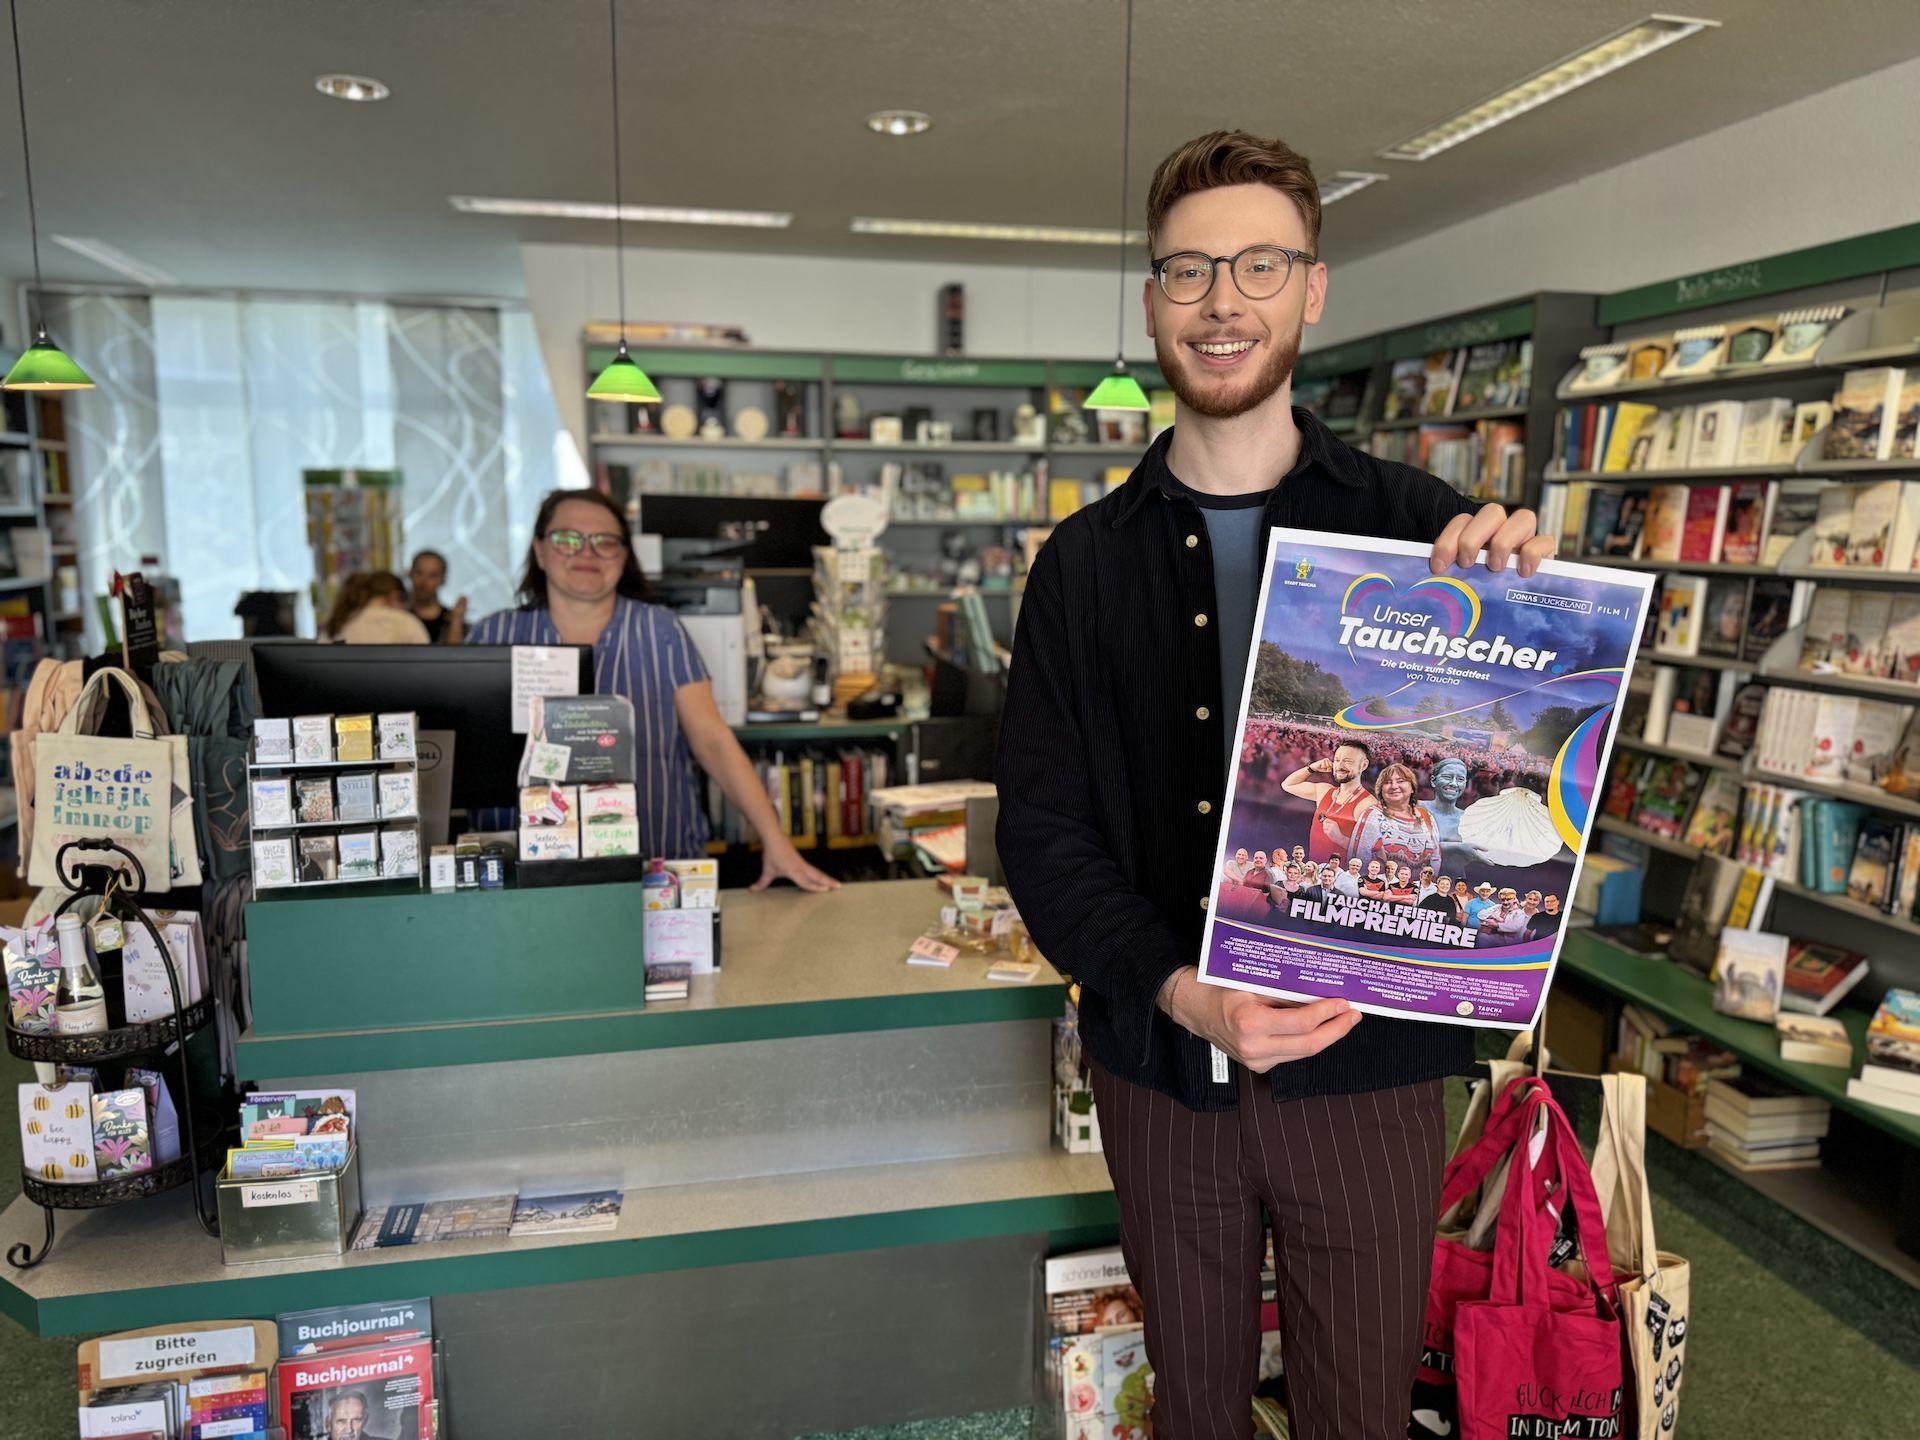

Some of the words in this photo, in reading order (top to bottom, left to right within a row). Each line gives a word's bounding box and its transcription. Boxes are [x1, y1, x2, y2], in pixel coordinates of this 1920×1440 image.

[1512, 592, 1538, 603] JONAS
[1540, 597, 1587, 610] JUCKELAND
[1597, 606, 1621, 616] FILM
[1374, 605, 1432, 627] Unser
[1381, 659, 1396, 669] Die
[1399, 661, 1424, 673] Doku
[1425, 666, 1445, 675] zum
[1445, 666, 1491, 681] Stadtfest
[1406, 673, 1424, 681] von
[1426, 674, 1461, 686] Taucha
[1327, 893, 1392, 915] TAUCHA
[1394, 905, 1447, 924] FEIERT
[1290, 898, 1478, 948] FILMPREMIERE
[103, 1120, 135, 1133] Danke
[252, 1190, 292, 1201] kostenlos
[298, 1311, 404, 1340] Buchjournal
[156, 1336, 197, 1351] Bitte
[135, 1352, 217, 1371] zugreifen
[296, 1356, 404, 1387] Buchjournal
[1517, 1382, 1564, 1413] GUCK
[111, 1411, 137, 1423] tolino
[1511, 1417, 1530, 1438] IN
[1587, 1417, 1620, 1438] TON
